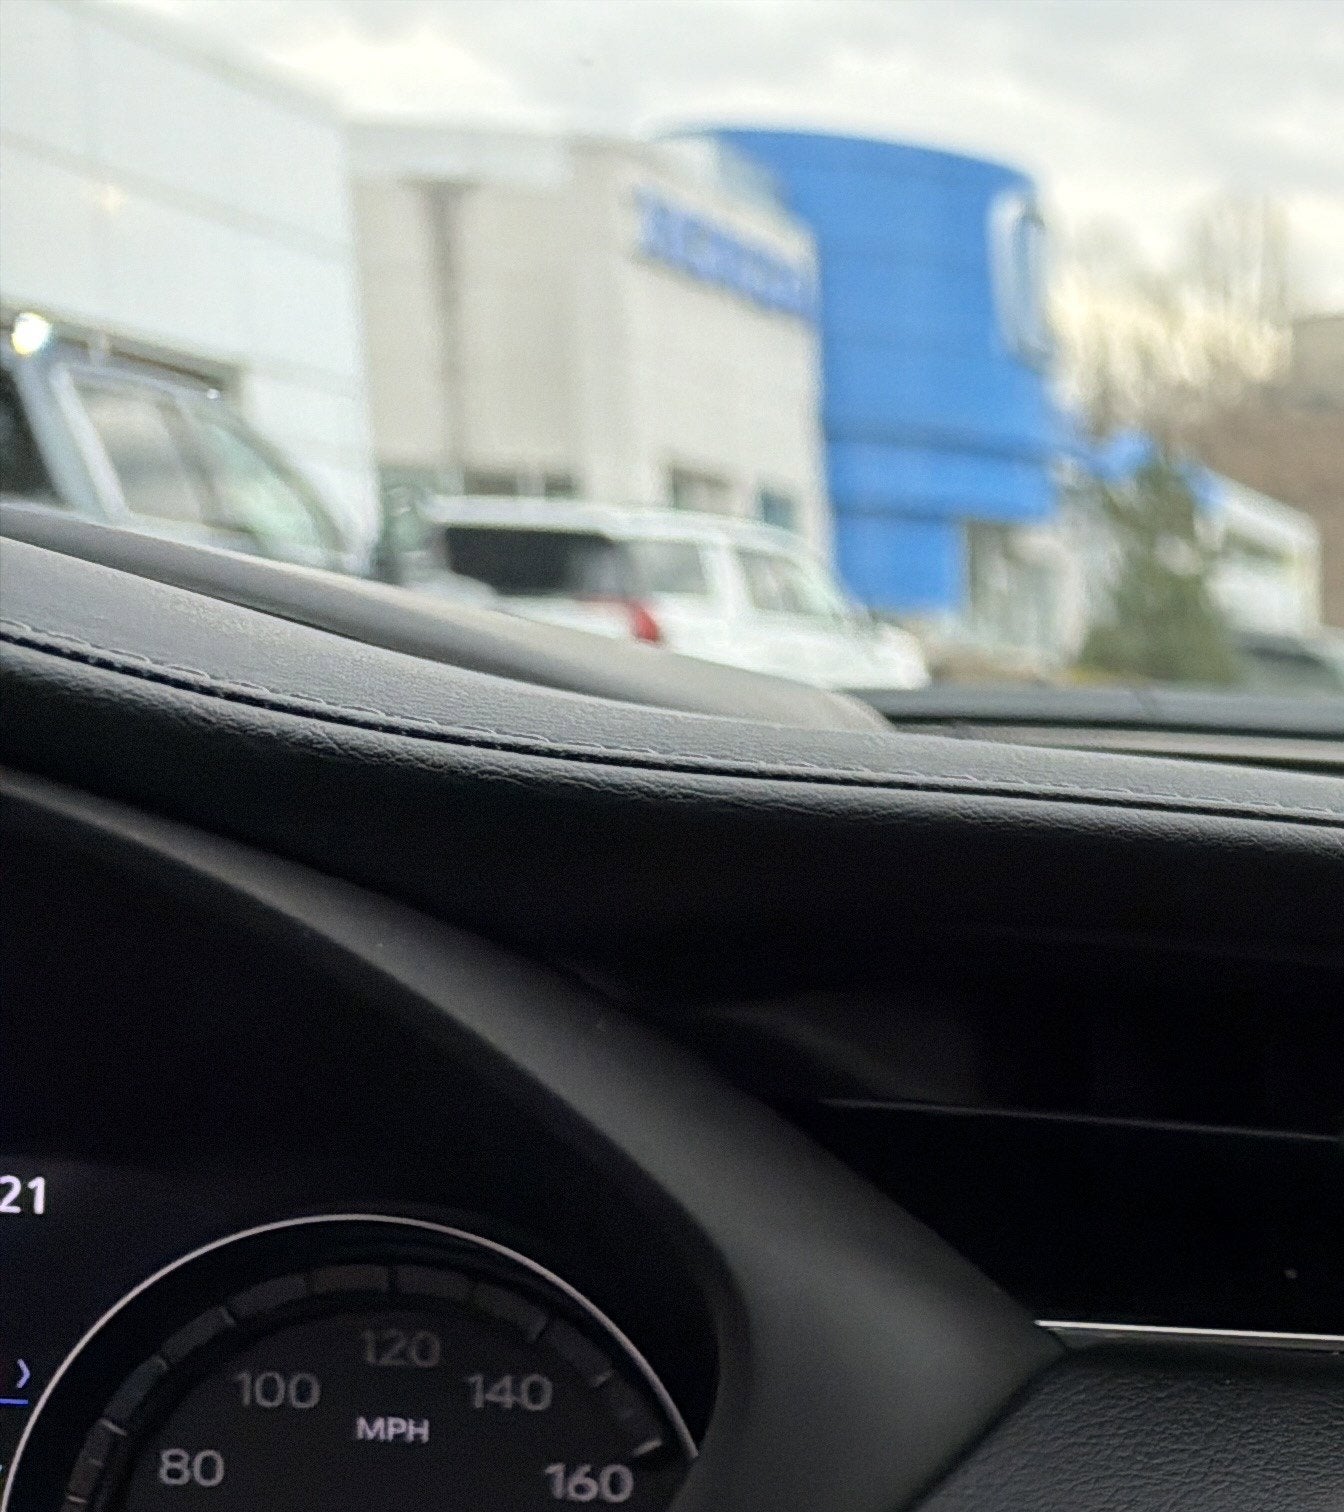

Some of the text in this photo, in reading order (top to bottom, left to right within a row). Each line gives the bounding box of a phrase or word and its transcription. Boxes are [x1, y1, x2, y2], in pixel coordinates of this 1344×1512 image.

[0, 1175, 45, 1215] 21
[363, 1329, 441, 1367] 120
[237, 1371, 320, 1410] 100
[467, 1373, 552, 1412] 140
[356, 1416, 429, 1444] MPH
[160, 1450, 224, 1487] 80
[545, 1462, 633, 1503] 160
